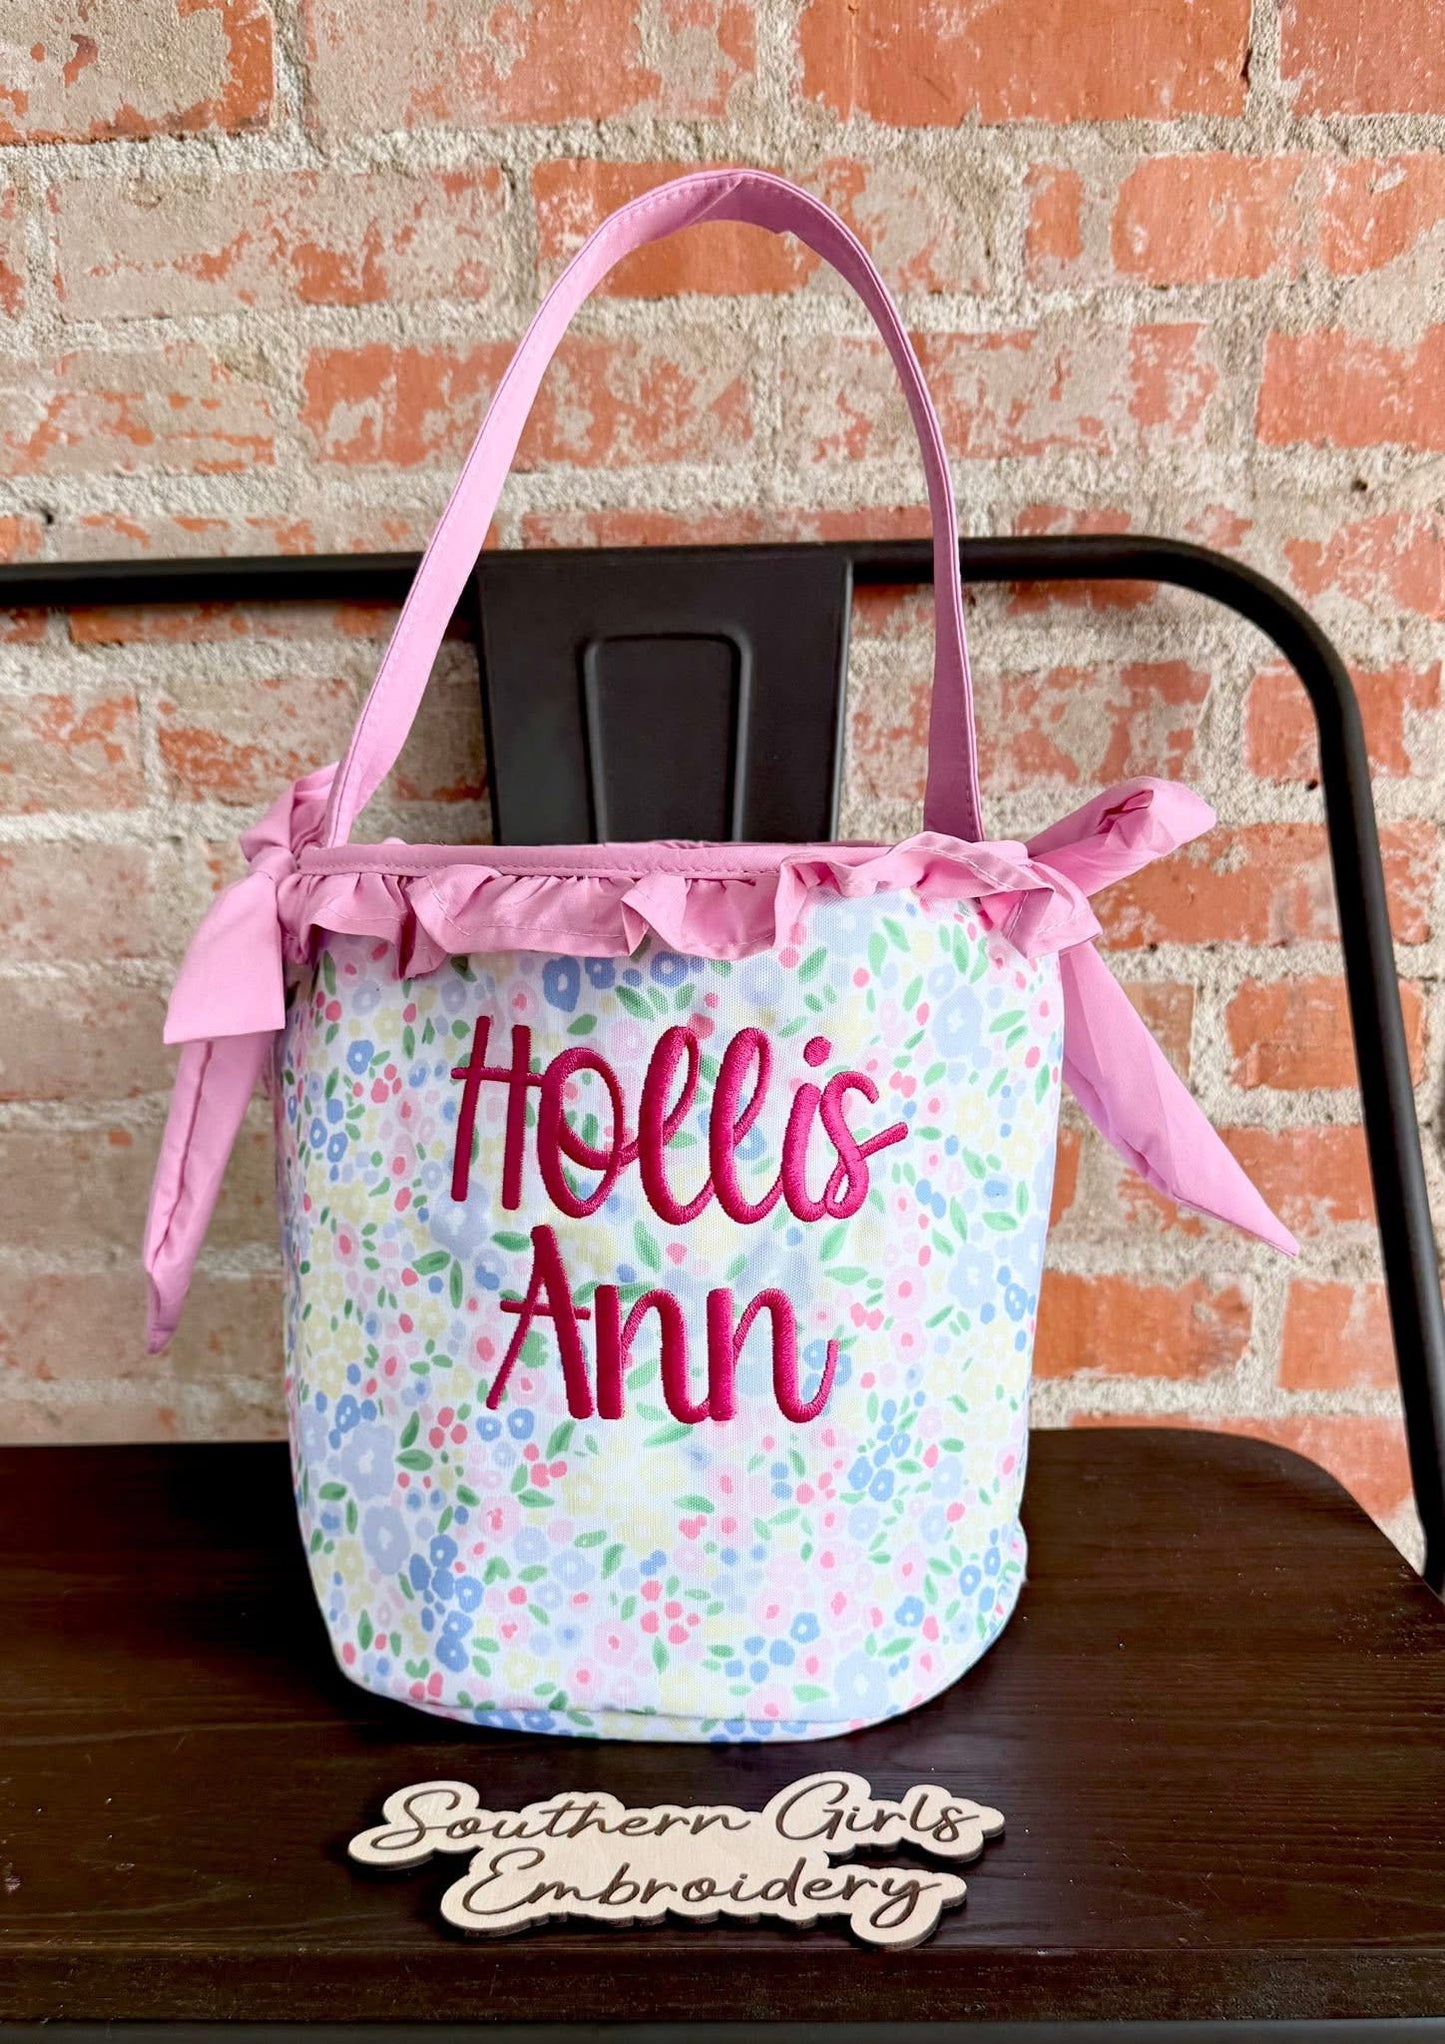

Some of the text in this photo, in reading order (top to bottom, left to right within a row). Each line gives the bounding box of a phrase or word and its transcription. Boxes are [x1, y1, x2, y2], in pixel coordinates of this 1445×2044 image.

[451, 1016, 908, 1225] Hollis
[486, 1224, 841, 1423] Ann
[371, 1781, 980, 1850] Southern Girls
[462, 1847, 942, 1928] Embroidery
